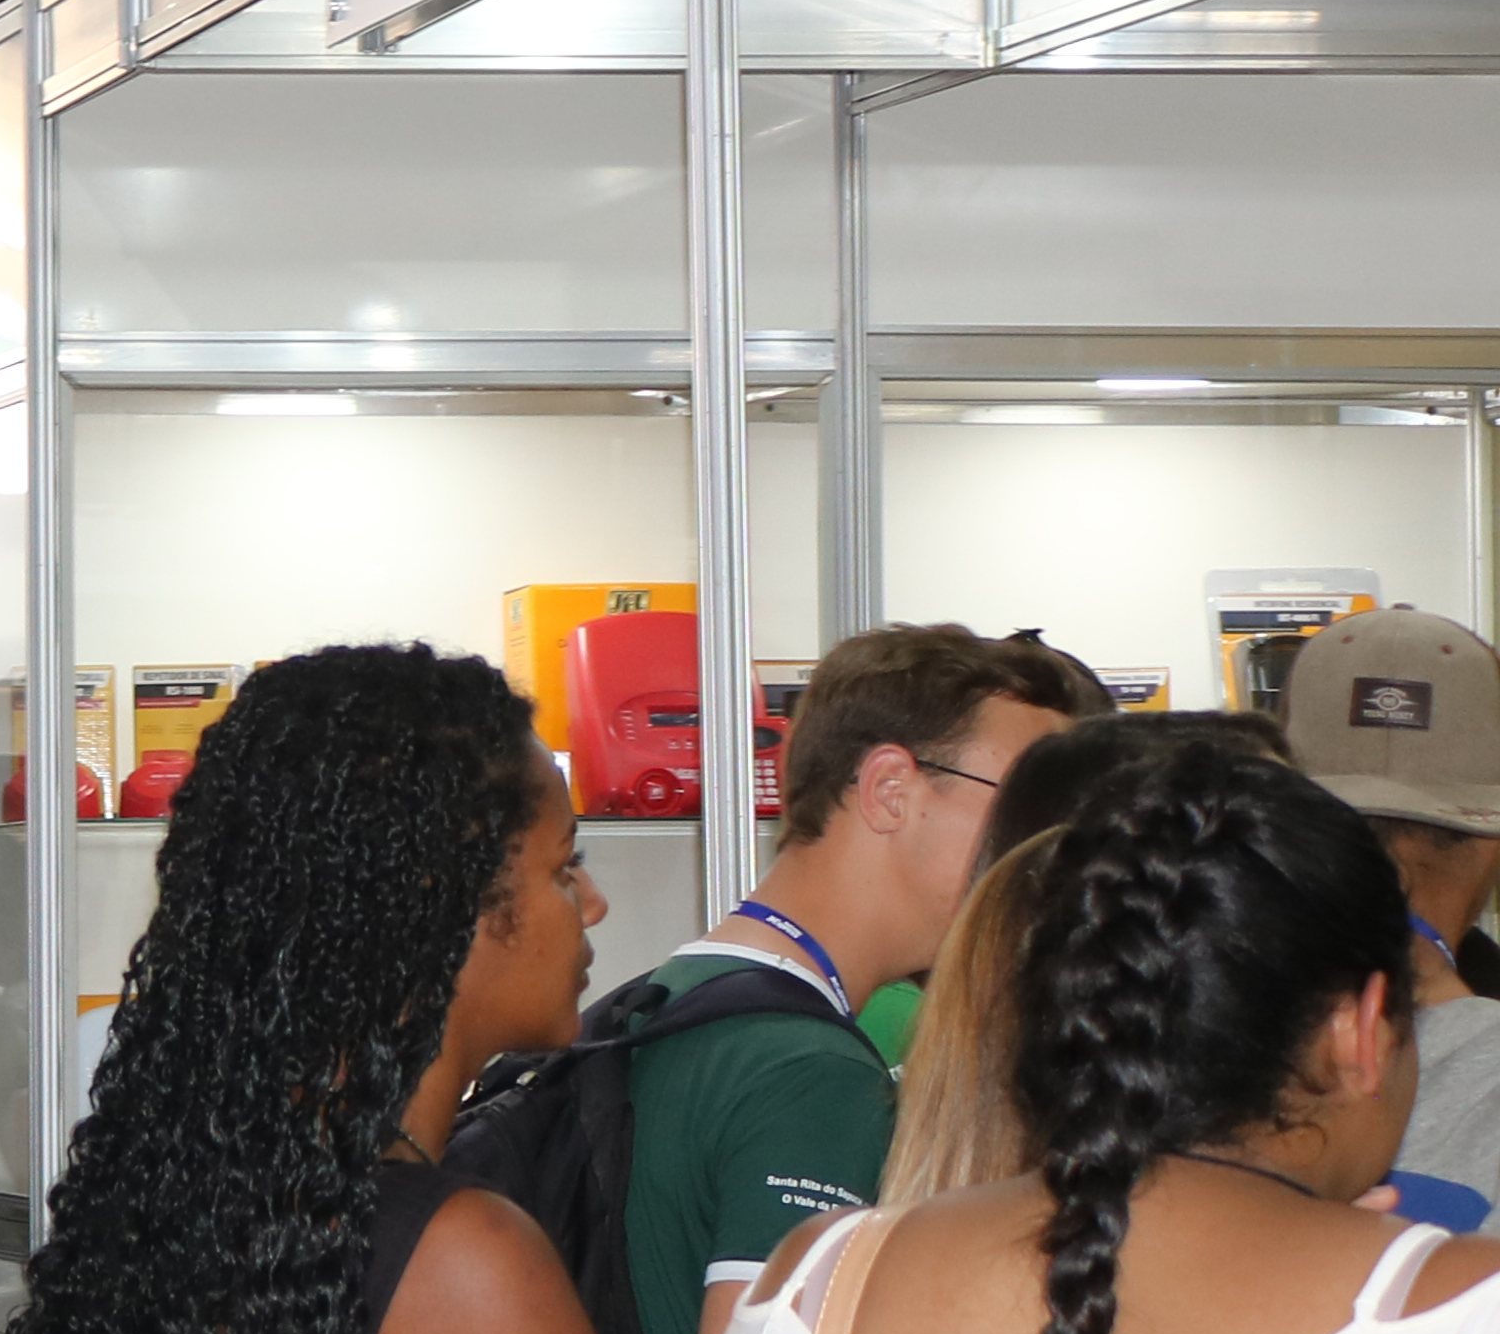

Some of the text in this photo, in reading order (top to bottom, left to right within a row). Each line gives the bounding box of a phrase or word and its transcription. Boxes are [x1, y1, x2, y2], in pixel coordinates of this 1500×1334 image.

[766, 1175, 799, 1187] Santa
[800, 1178, 821, 1191] Rita
[823, 1183, 836, 1195] do
[781, 1193, 792, 1204] O
[794, 1195, 817, 1208] Vale
[818, 1200, 830, 1212] da
